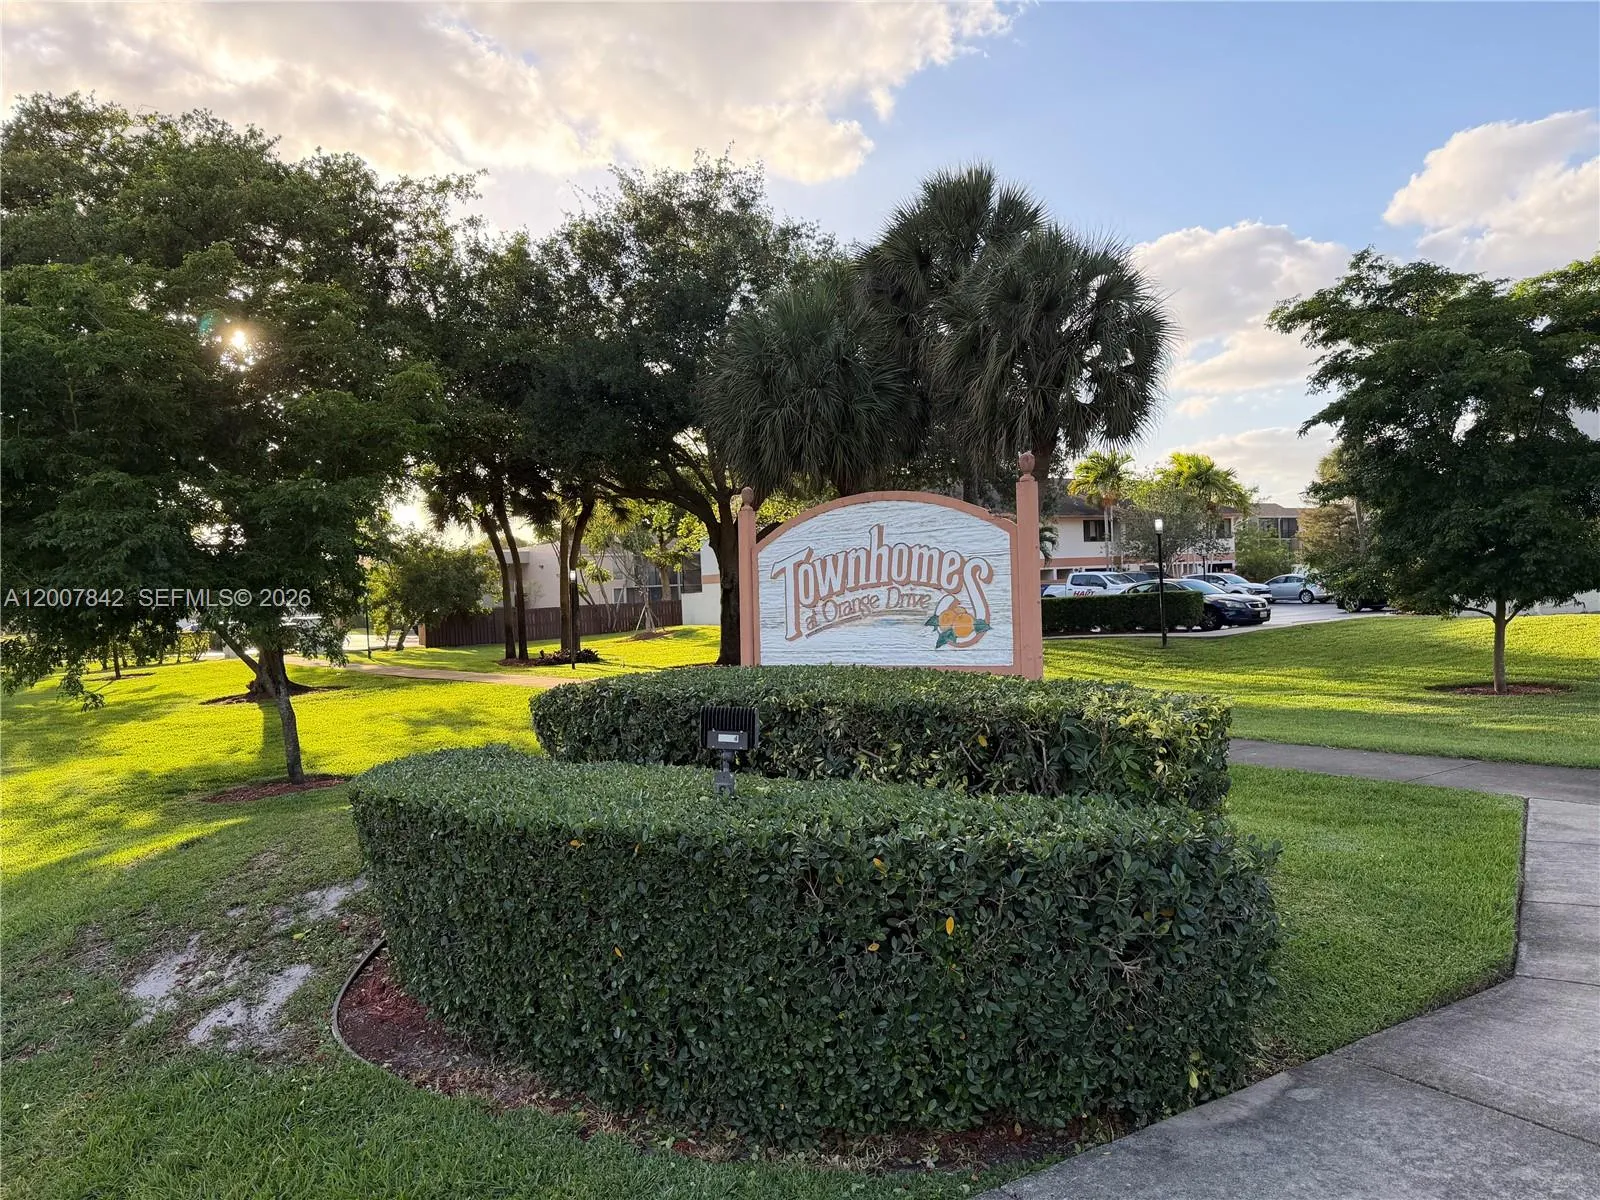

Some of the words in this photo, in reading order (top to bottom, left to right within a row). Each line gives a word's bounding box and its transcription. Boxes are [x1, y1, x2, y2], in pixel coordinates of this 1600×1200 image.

[770, 523, 993, 648] Townhomes
[805, 609, 819, 631] at
[821, 594, 880, 622] Orange
[885, 586, 932, 609] Drive
